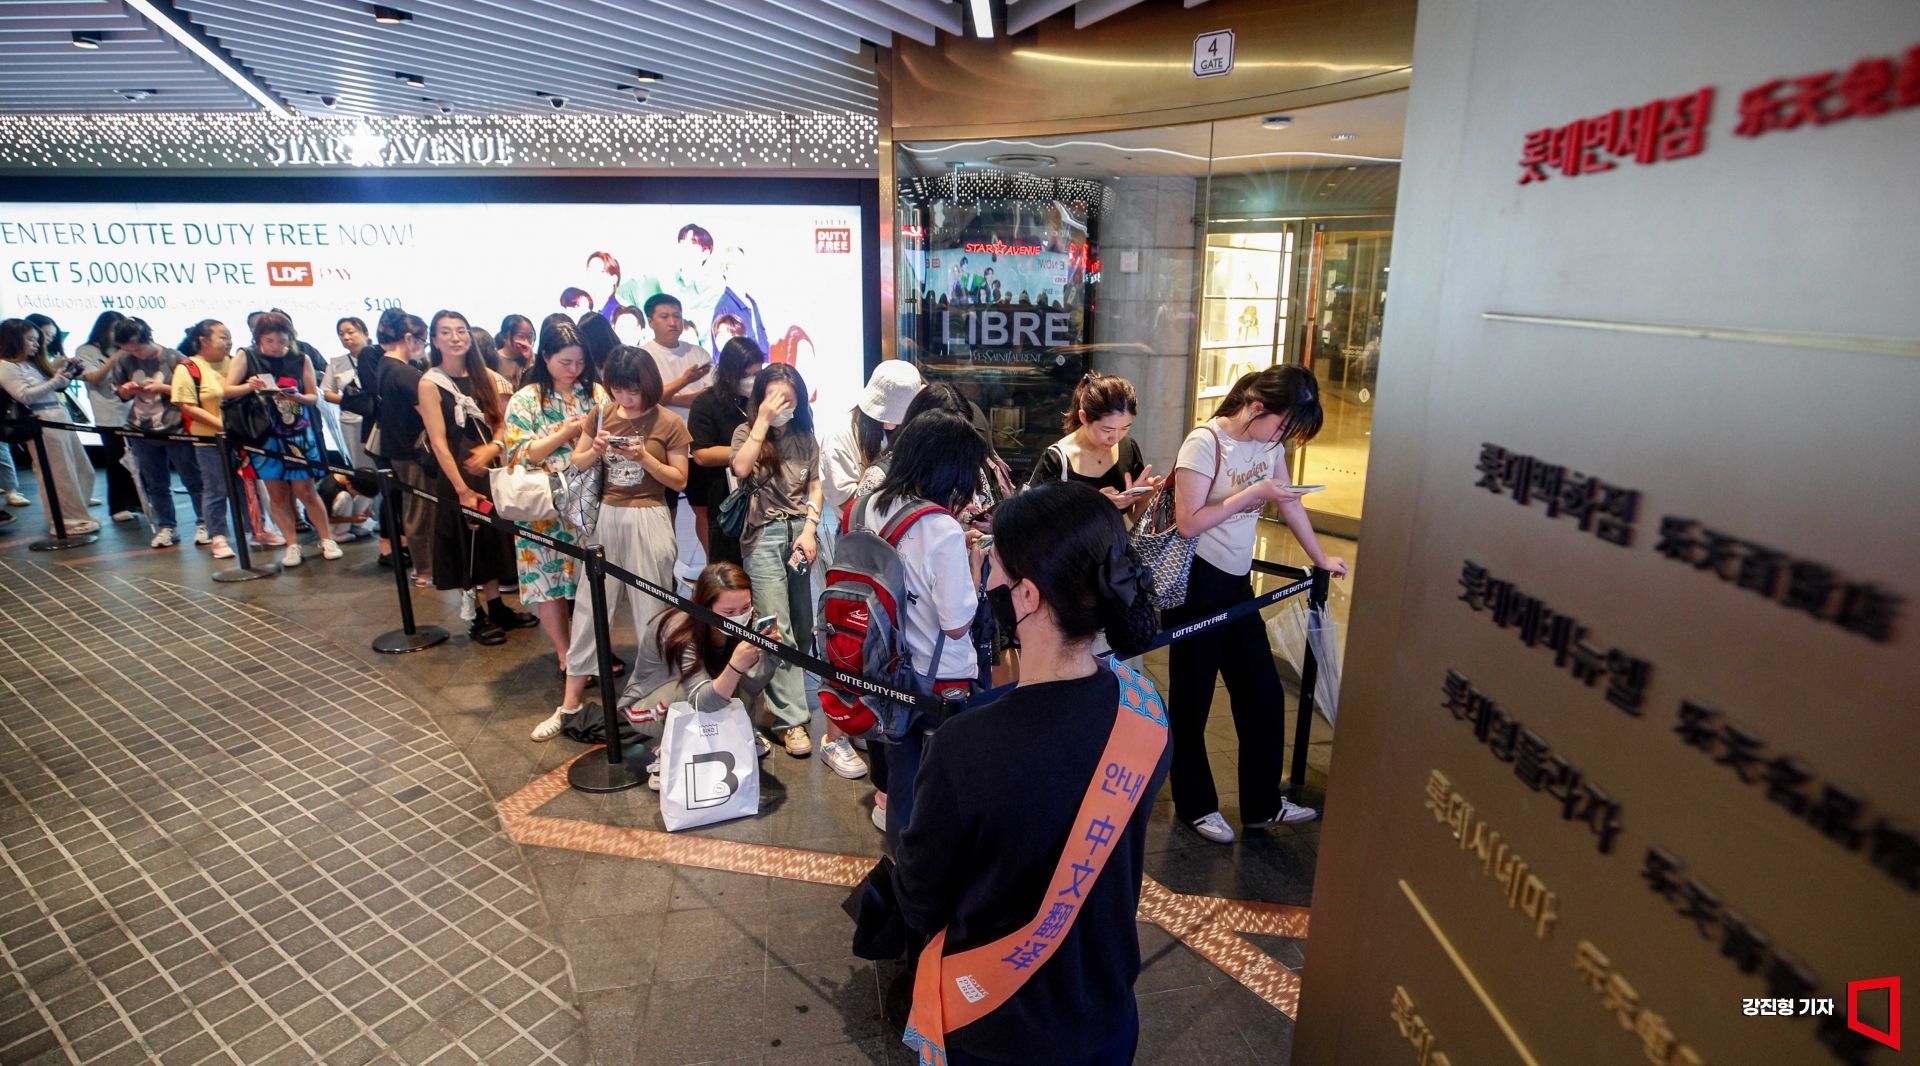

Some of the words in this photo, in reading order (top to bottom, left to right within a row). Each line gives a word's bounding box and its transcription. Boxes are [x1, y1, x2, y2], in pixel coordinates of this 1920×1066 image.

[1208, 37, 1218, 56] 4
[1200, 57, 1223, 70] GATE
[1517, 85, 1718, 186] 롯데면세점
[387, 133, 514, 166] AVENUE
[1, 222, 87, 246] ENTER
[94, 222, 176, 246] LOTTE
[183, 222, 254, 246] DUTY
[264, 223, 330, 246] FREE
[338, 223, 415, 248] NOW!
[817, 231, 849, 241] DUTY
[817, 240, 849, 251] FREE
[965, 243, 993, 254] STAR
[1005, 244, 1042, 256] AVENUE
[12, 261, 62, 285] GET
[70, 261, 196, 287] 5,000KRW
[206, 262, 256, 285] PRE
[270, 266, 312, 283] LDF
[942, 311, 1071, 346] LIBRE
[635, 579, 652, 592] LOTTE
[651, 585, 666, 599] DUTY
[665, 593, 679, 605] FREE
[1272, 588, 1289, 600] LOTTE
[1289, 583, 1304, 594] DUTY
[723, 620, 743, 635] LOTTE
[743, 629, 761, 645] DUTY
[760, 636, 779, 652] FREE
[1172, 625, 1194, 639] LOTTE
[1193, 619, 1212, 631] DUTY
[1211, 612, 1228, 624] FREE
[836, 671, 863, 688] LOTTE
[863, 681, 890, 697] DUTY
[890, 690, 916, 705] FREE
[1441, 668, 1622, 855] 롯데영플라자
[1101, 762, 1145, 803] 안내
[1425, 769, 1558, 940] 롯데시네마
